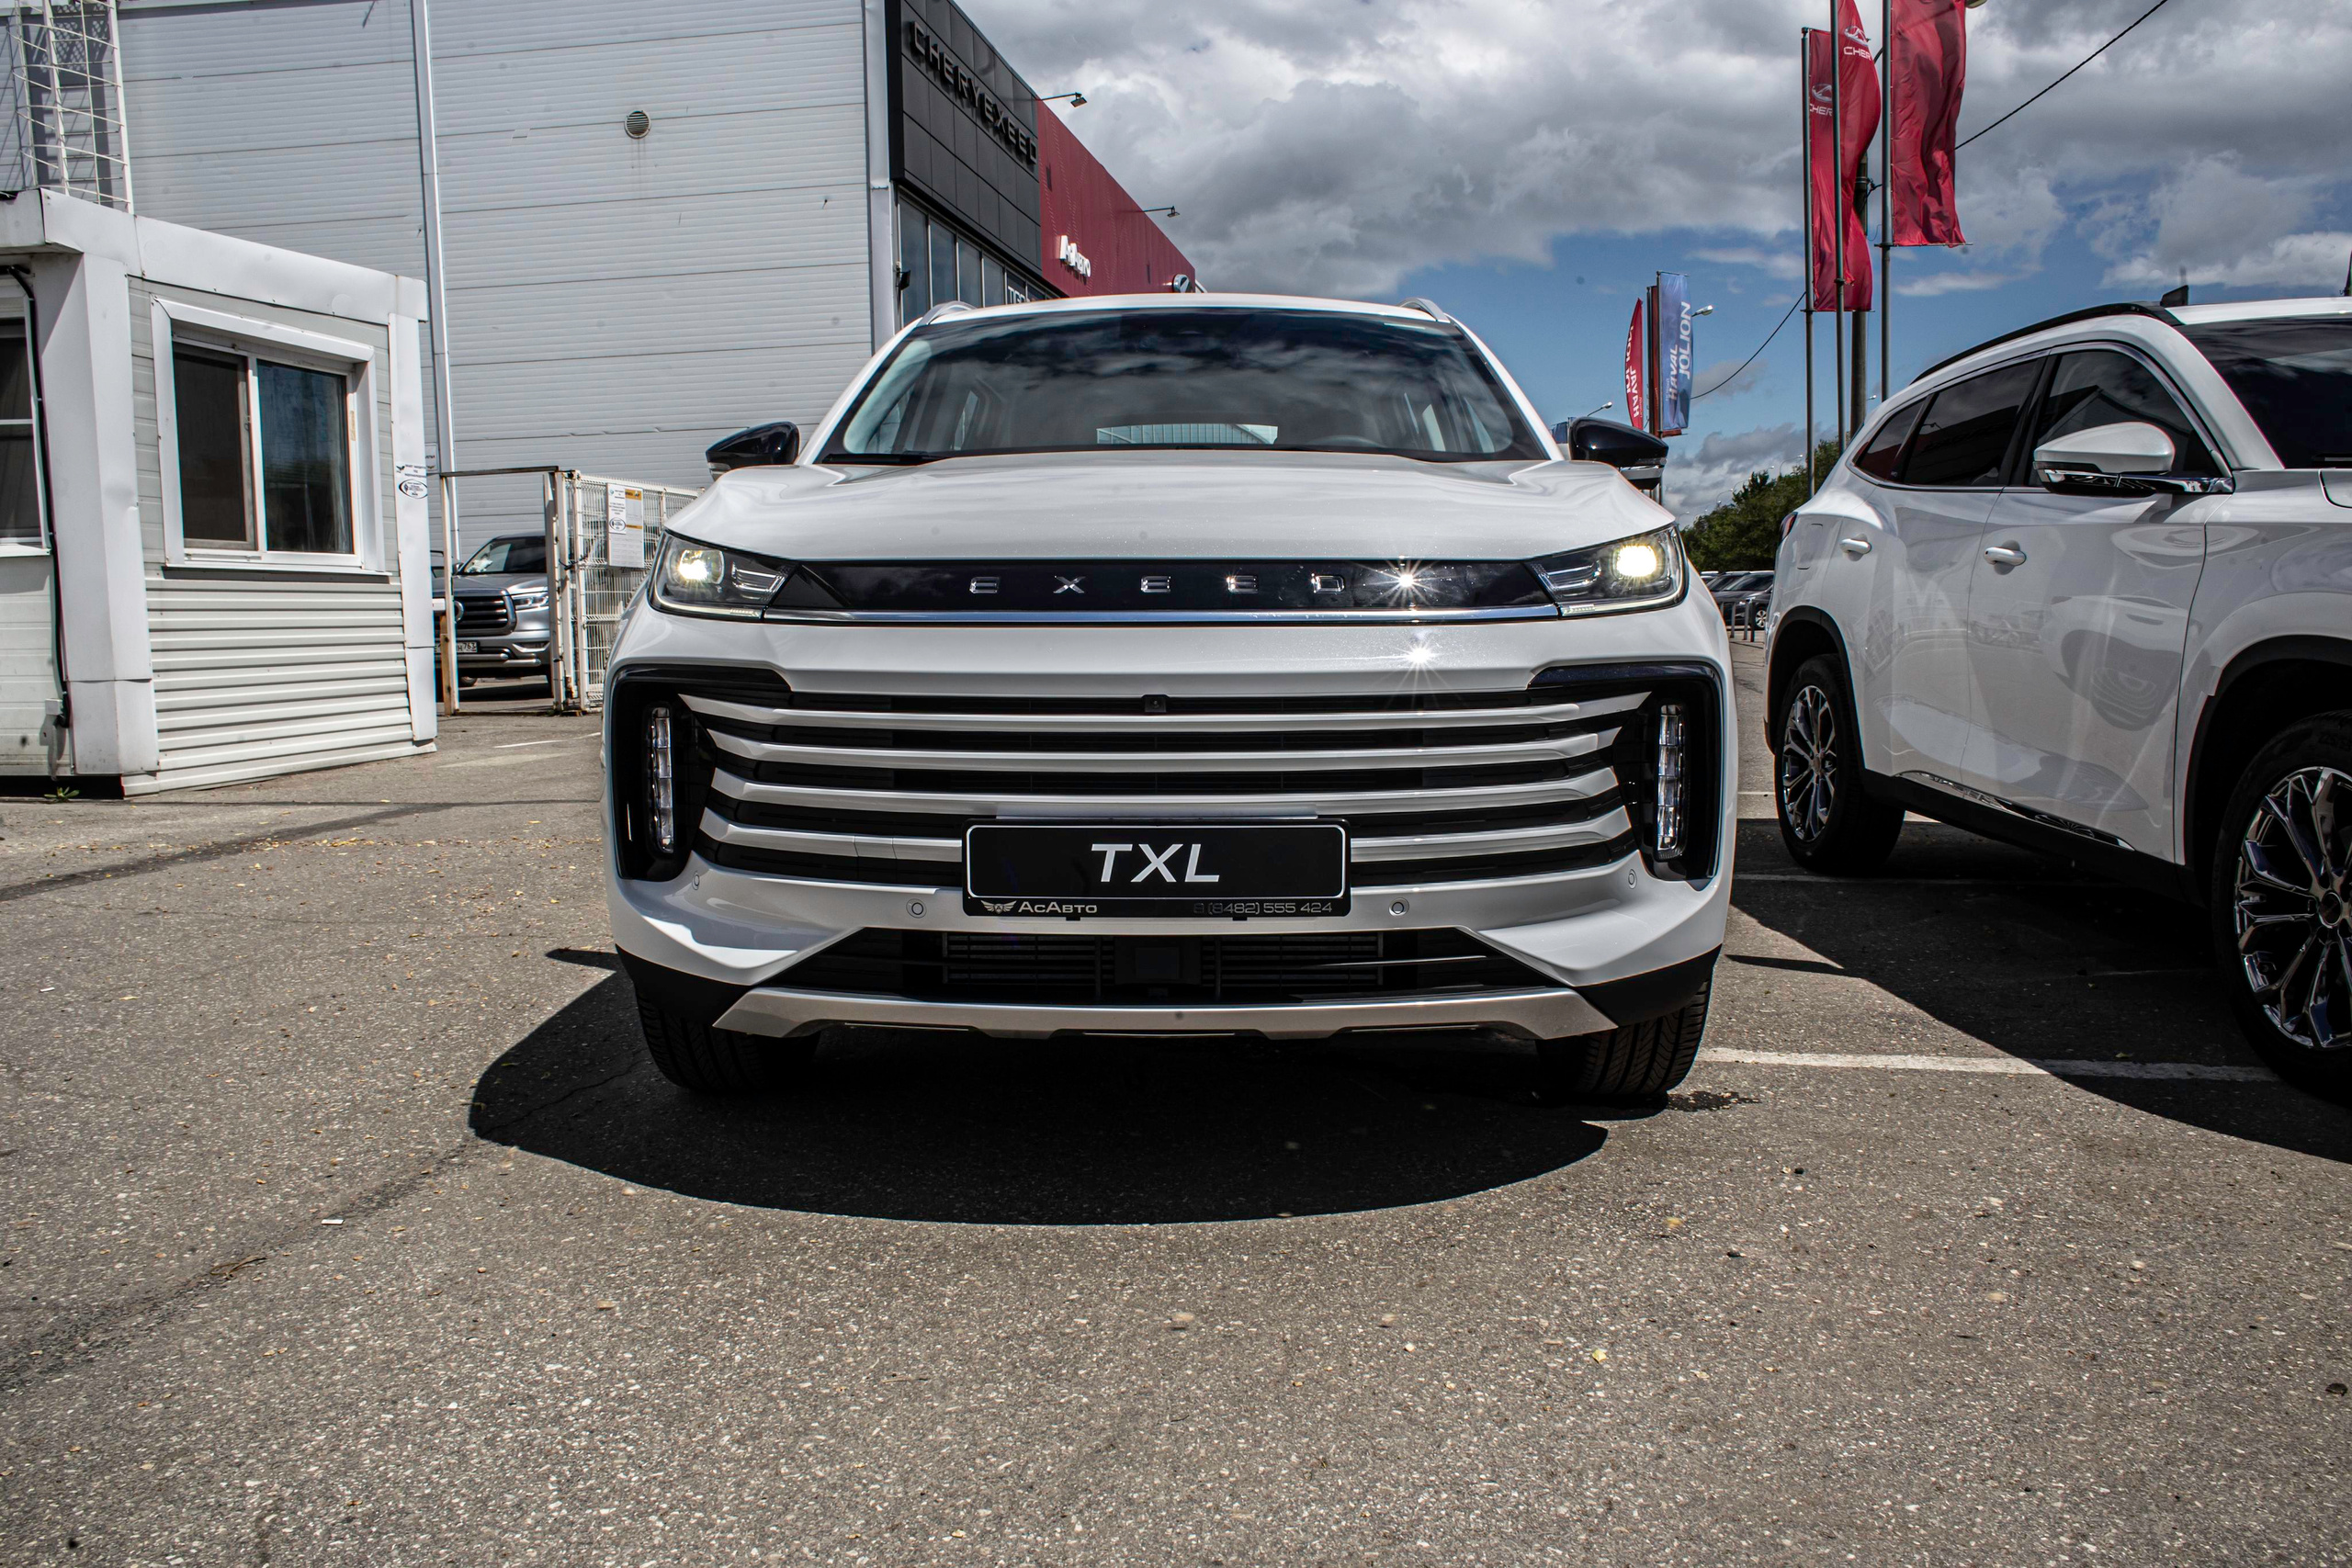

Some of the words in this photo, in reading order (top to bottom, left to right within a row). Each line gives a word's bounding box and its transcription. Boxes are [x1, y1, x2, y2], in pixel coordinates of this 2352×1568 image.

[1843, 46, 1871, 61] CHER
[1679, 301, 1691, 380] JOLION
[1668, 344, 1679, 401] HAVAL
[968, 575, 1345, 594] EXEED
[1091, 842, 1220, 883] TXL
[1207, 902, 1261, 915] (8482)
[1263, 902, 1296, 913] 555
[1300, 902, 1333, 913] 424
